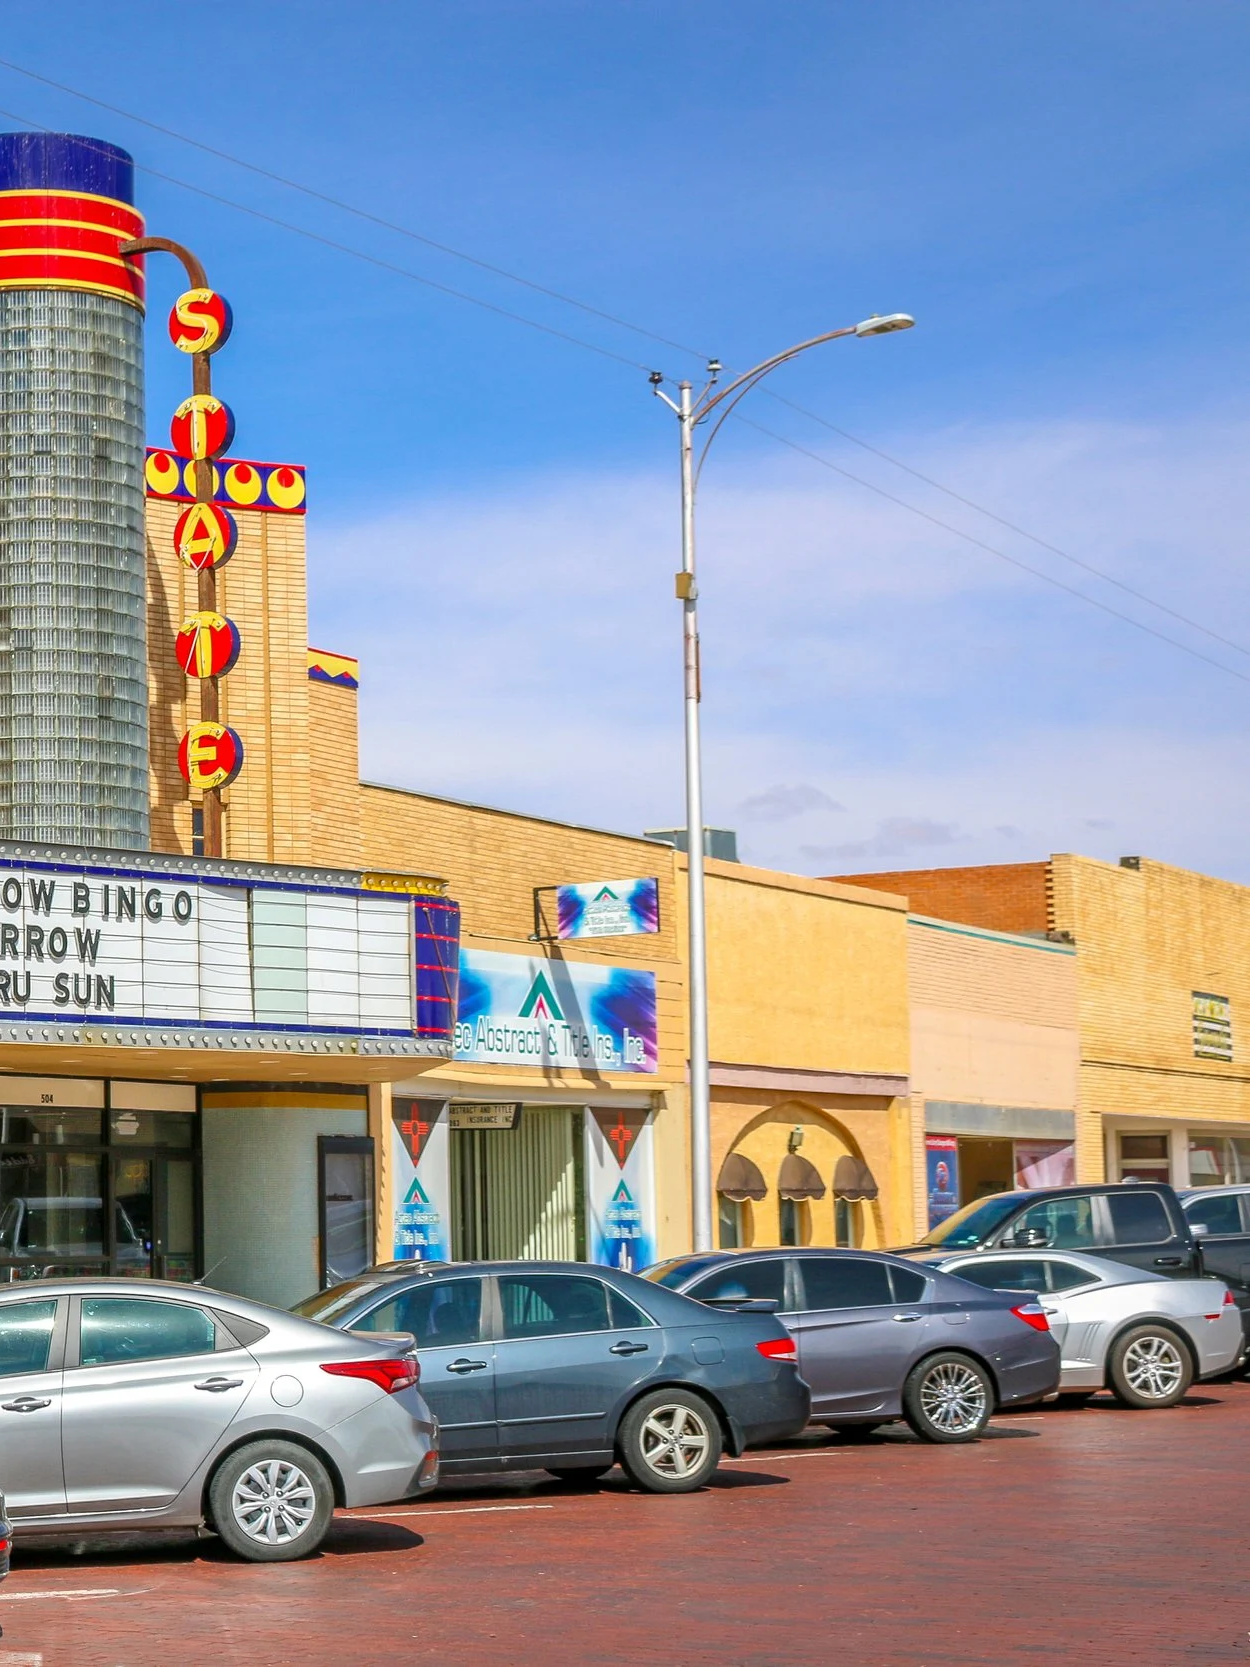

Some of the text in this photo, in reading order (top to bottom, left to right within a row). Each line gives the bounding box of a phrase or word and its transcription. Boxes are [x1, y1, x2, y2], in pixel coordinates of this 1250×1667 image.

[171, 287, 232, 789] STATE
[71, 881, 192, 925] BINGO
[53, 972, 116, 1011] SUN
[475, 1015, 542, 1056] Abstract
[547, 1023, 560, 1056] &
[562, 1023, 591, 1060] Title
[41, 1094, 54, 1104] 504
[494, 1105, 513, 1114] TITLE
